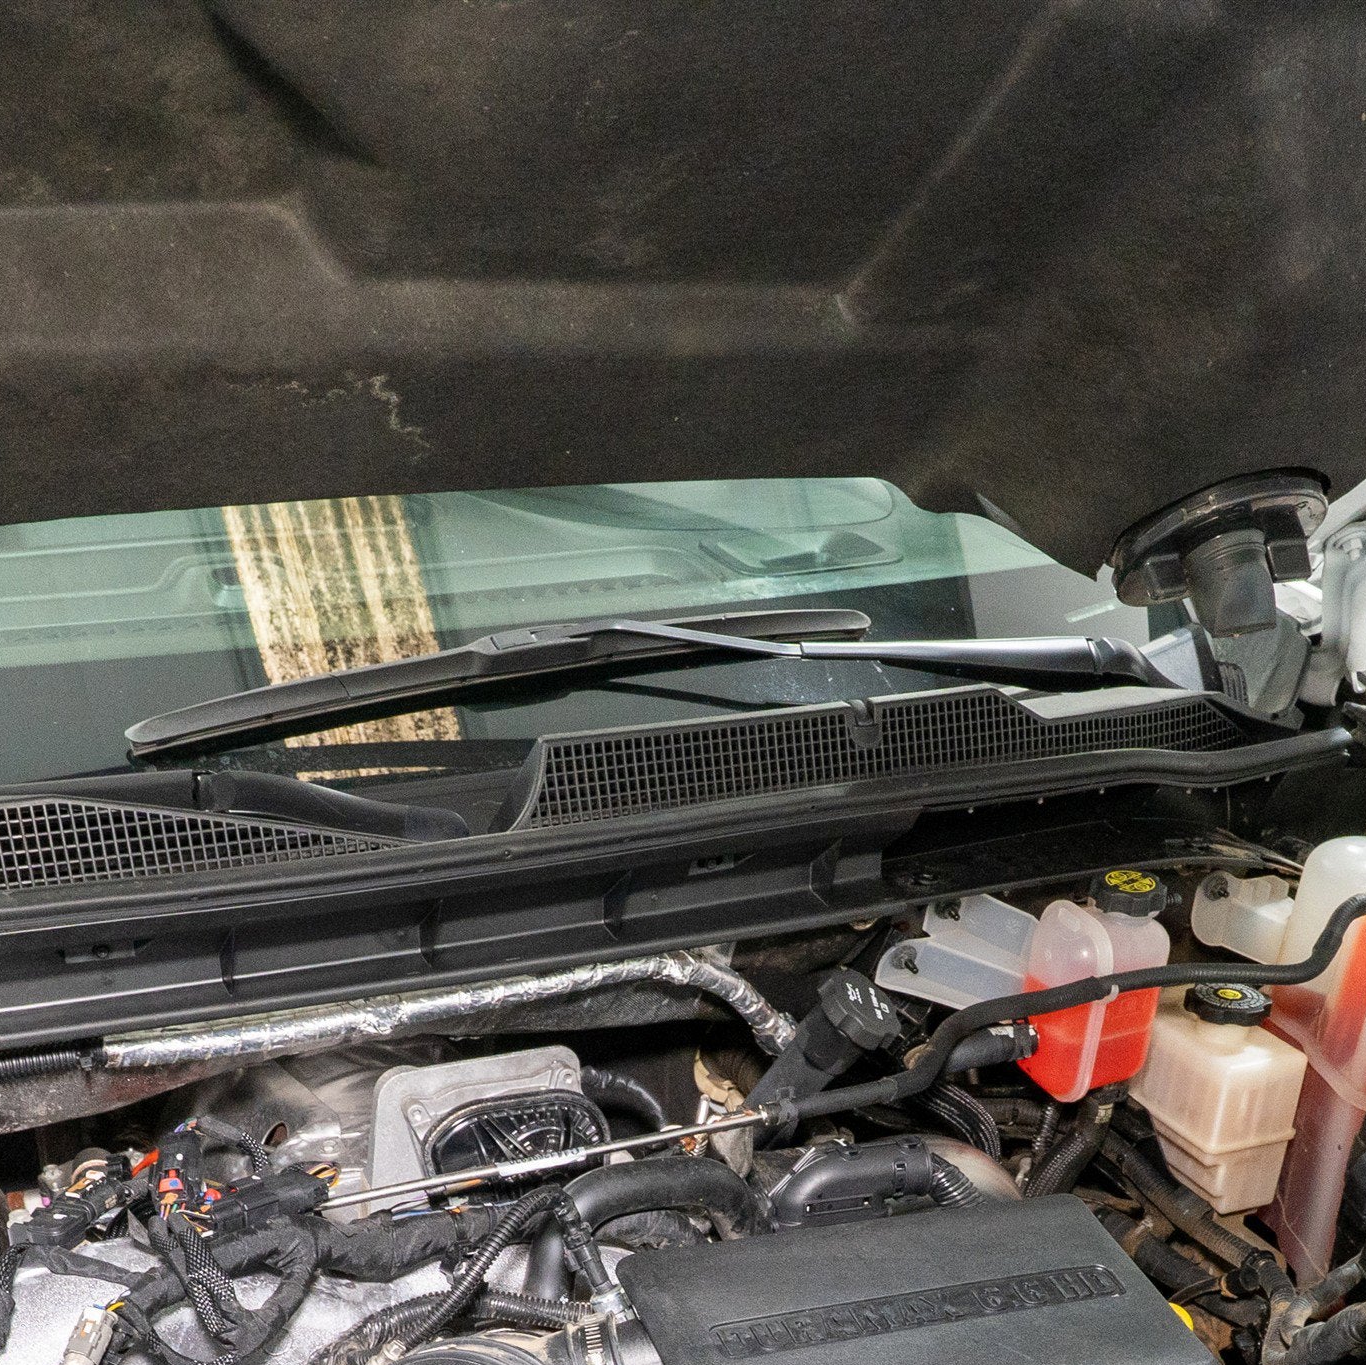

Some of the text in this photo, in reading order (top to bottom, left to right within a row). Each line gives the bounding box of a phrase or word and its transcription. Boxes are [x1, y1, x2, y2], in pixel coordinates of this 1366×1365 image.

[716, 1270, 1119, 1357] DURAMAX 6.6 HD
